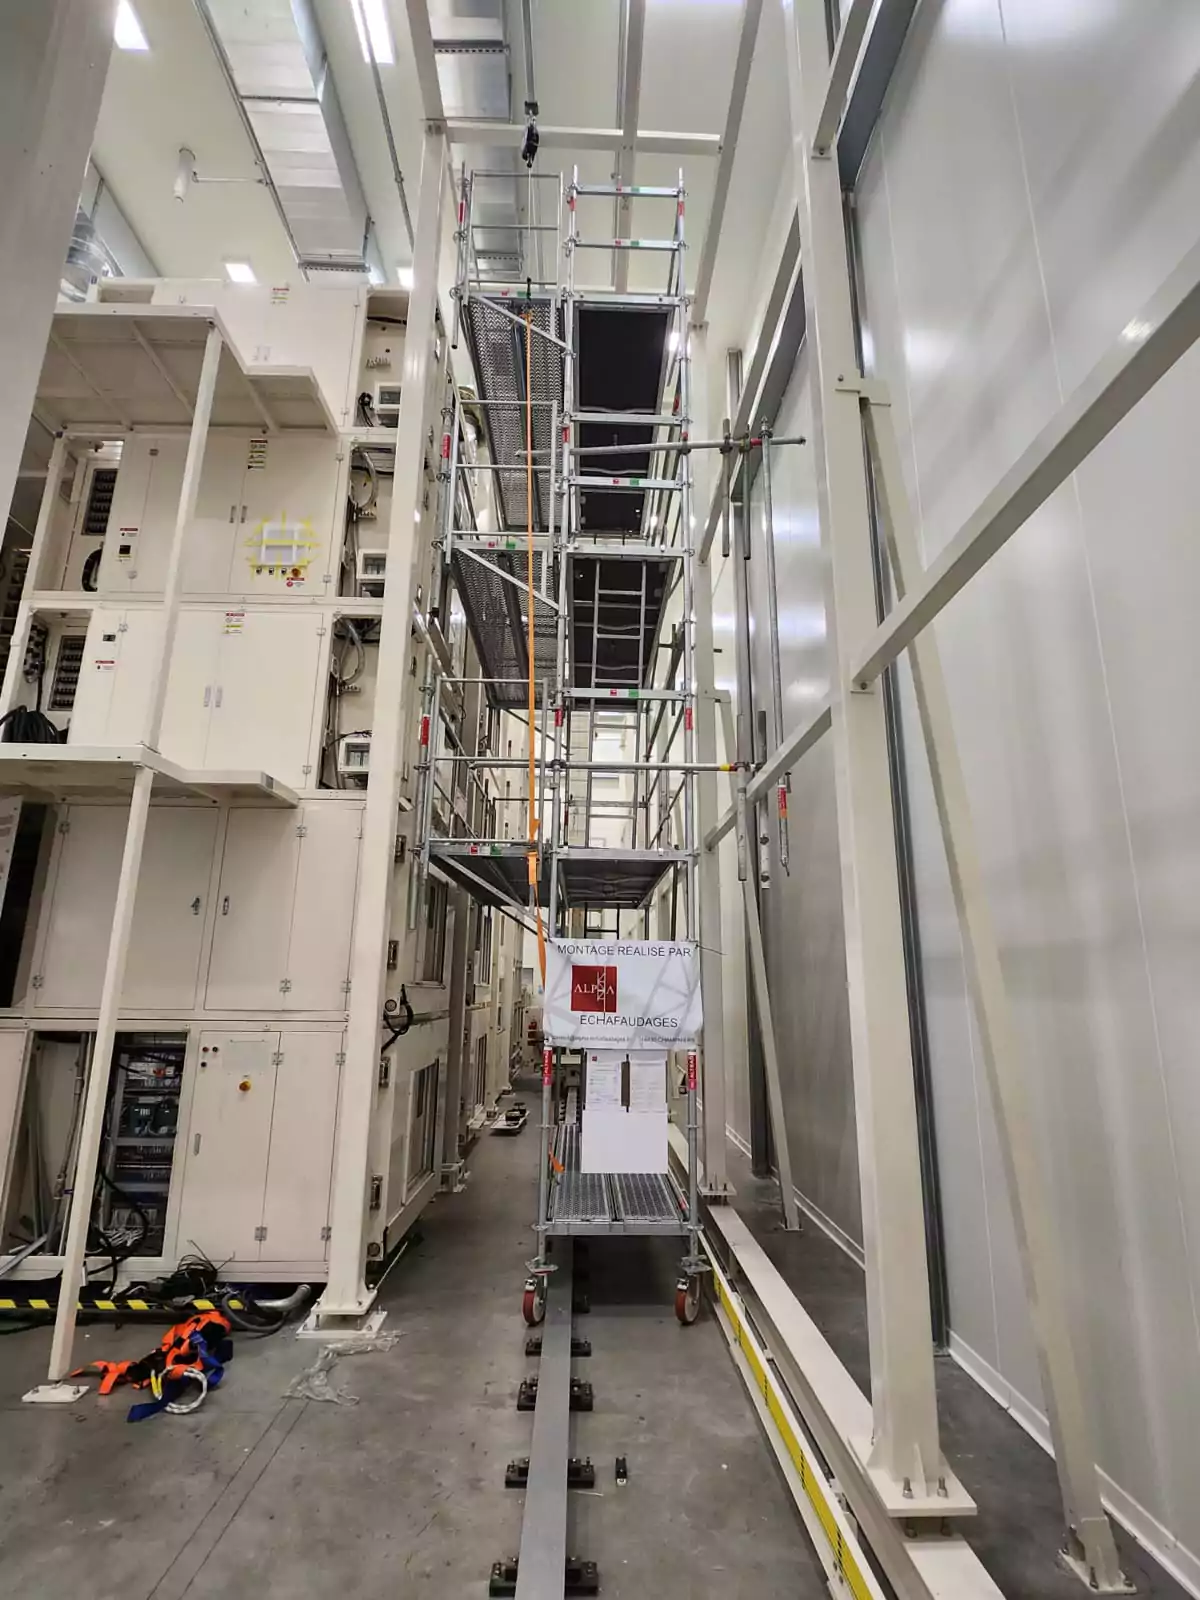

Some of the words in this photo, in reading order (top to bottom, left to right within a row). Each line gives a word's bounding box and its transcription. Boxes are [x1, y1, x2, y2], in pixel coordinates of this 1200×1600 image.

[557, 944, 615, 956] MONTAGE
[617, 944, 665, 957] RÉALISÉ
[668, 947, 692, 957] PAR
[580, 1014, 678, 1028] ECHAFAUDAGES
